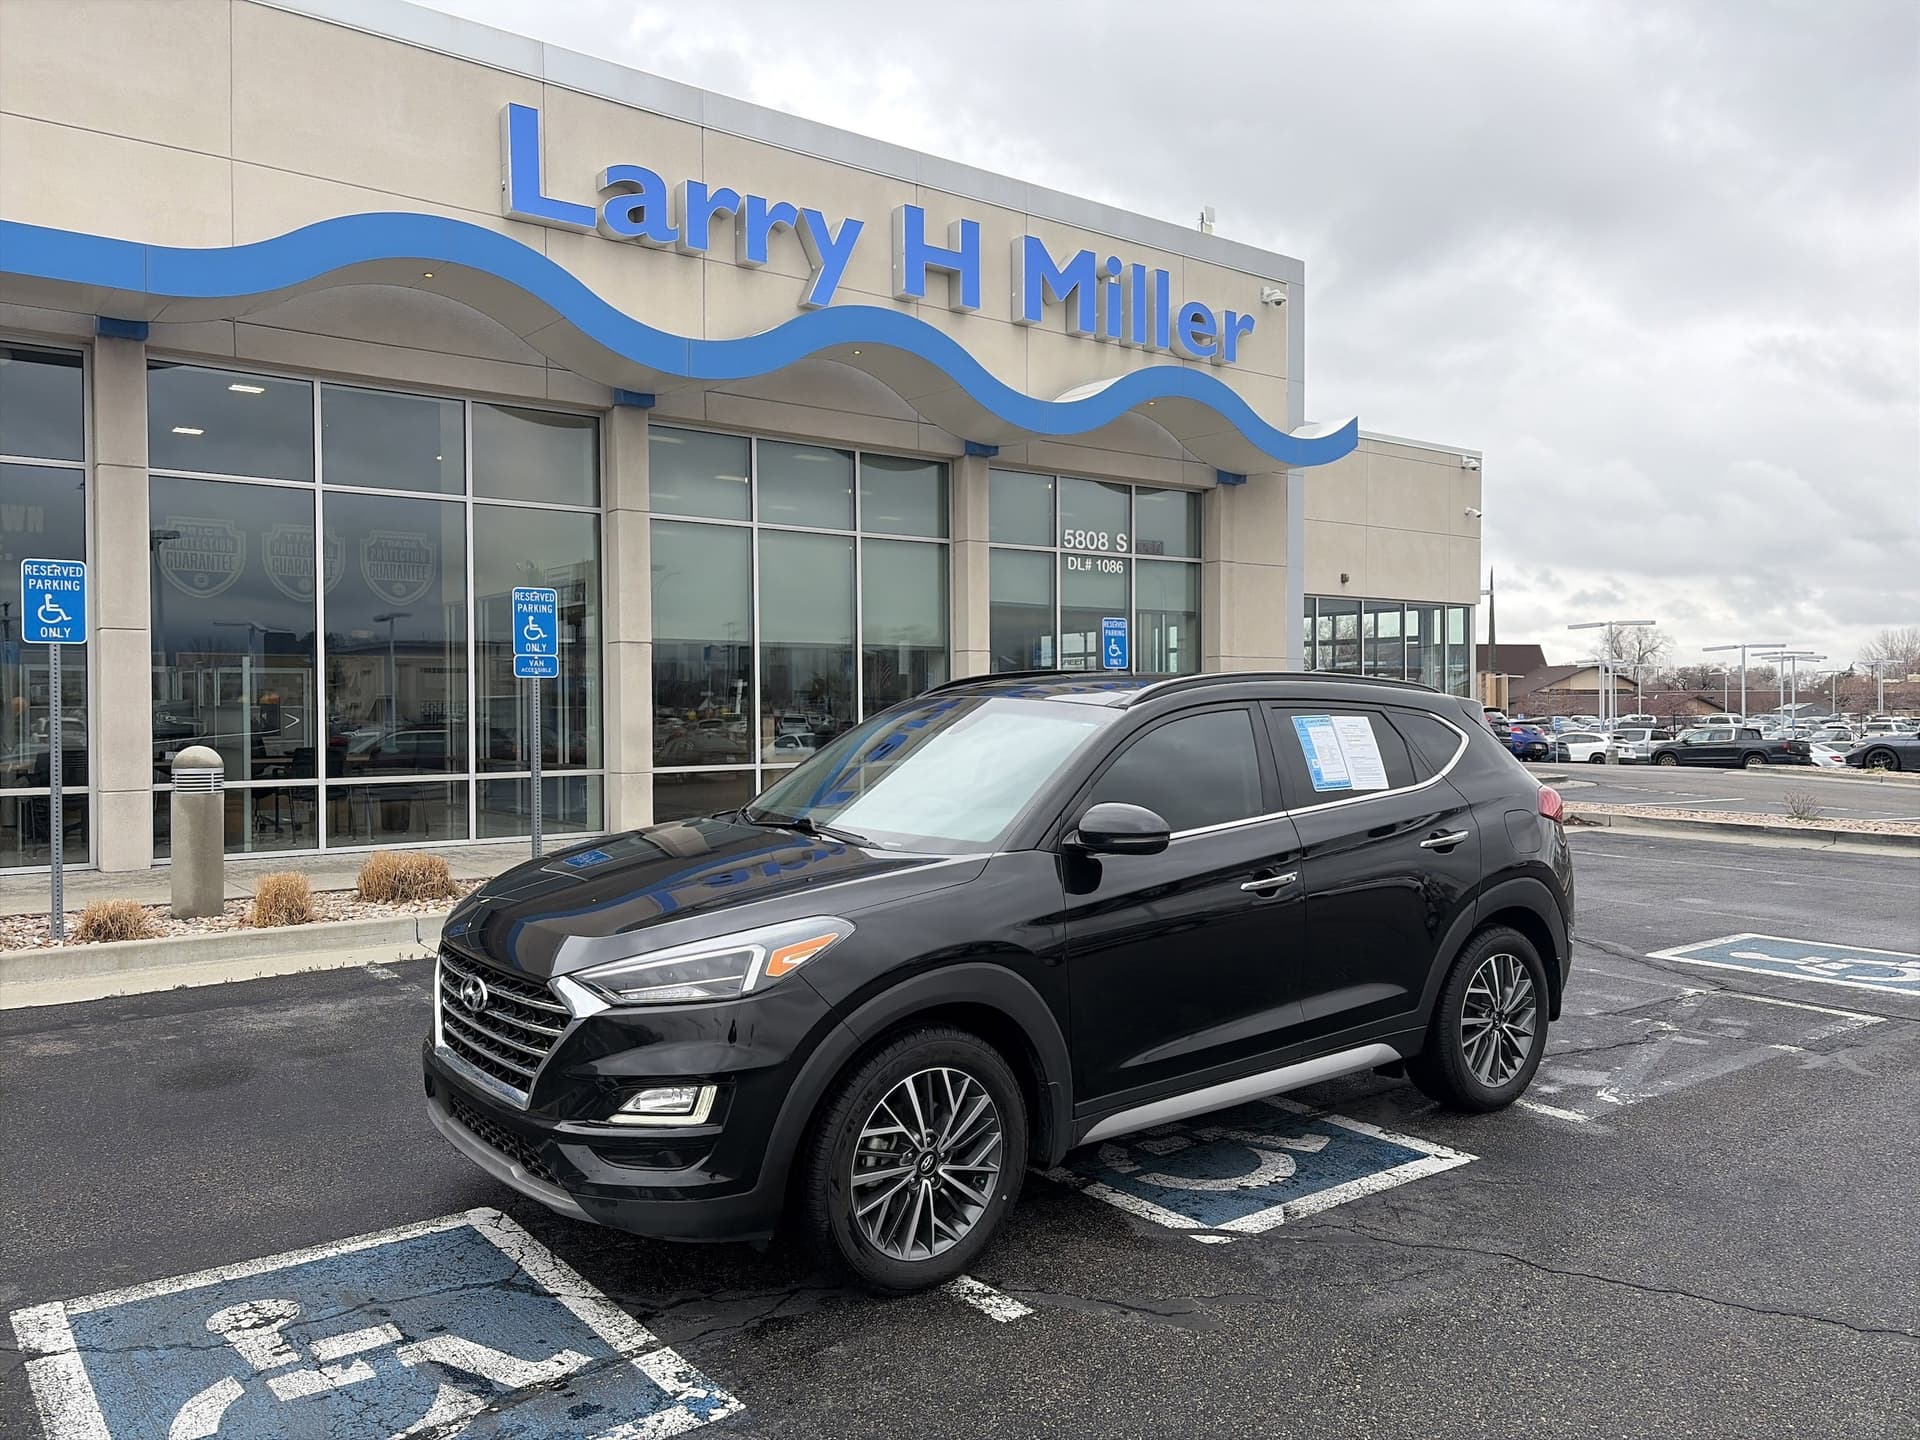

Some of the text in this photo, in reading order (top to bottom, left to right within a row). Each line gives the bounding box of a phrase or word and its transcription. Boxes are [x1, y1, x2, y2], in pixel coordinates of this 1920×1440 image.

[503, 102, 1256, 364] Larry H Miller
[1063, 529, 1109, 551] 5808
[1115, 533, 1128, 552] S
[165, 551, 236, 571] GUARANTEE
[1067, 556, 1124, 574] DL# 1086
[24, 564, 84, 577] RESERVED
[368, 561, 430, 580] GUARANTEE
[28, 578, 80, 591] PARKING
[514, 591, 555, 602] RESERVED
[517, 604, 553, 614] PARKING
[40, 626, 71, 638] ONLY
[1105, 629, 1125, 637] PARKING
[525, 642, 547, 653] ONLY
[529, 659, 545, 667] VAN
